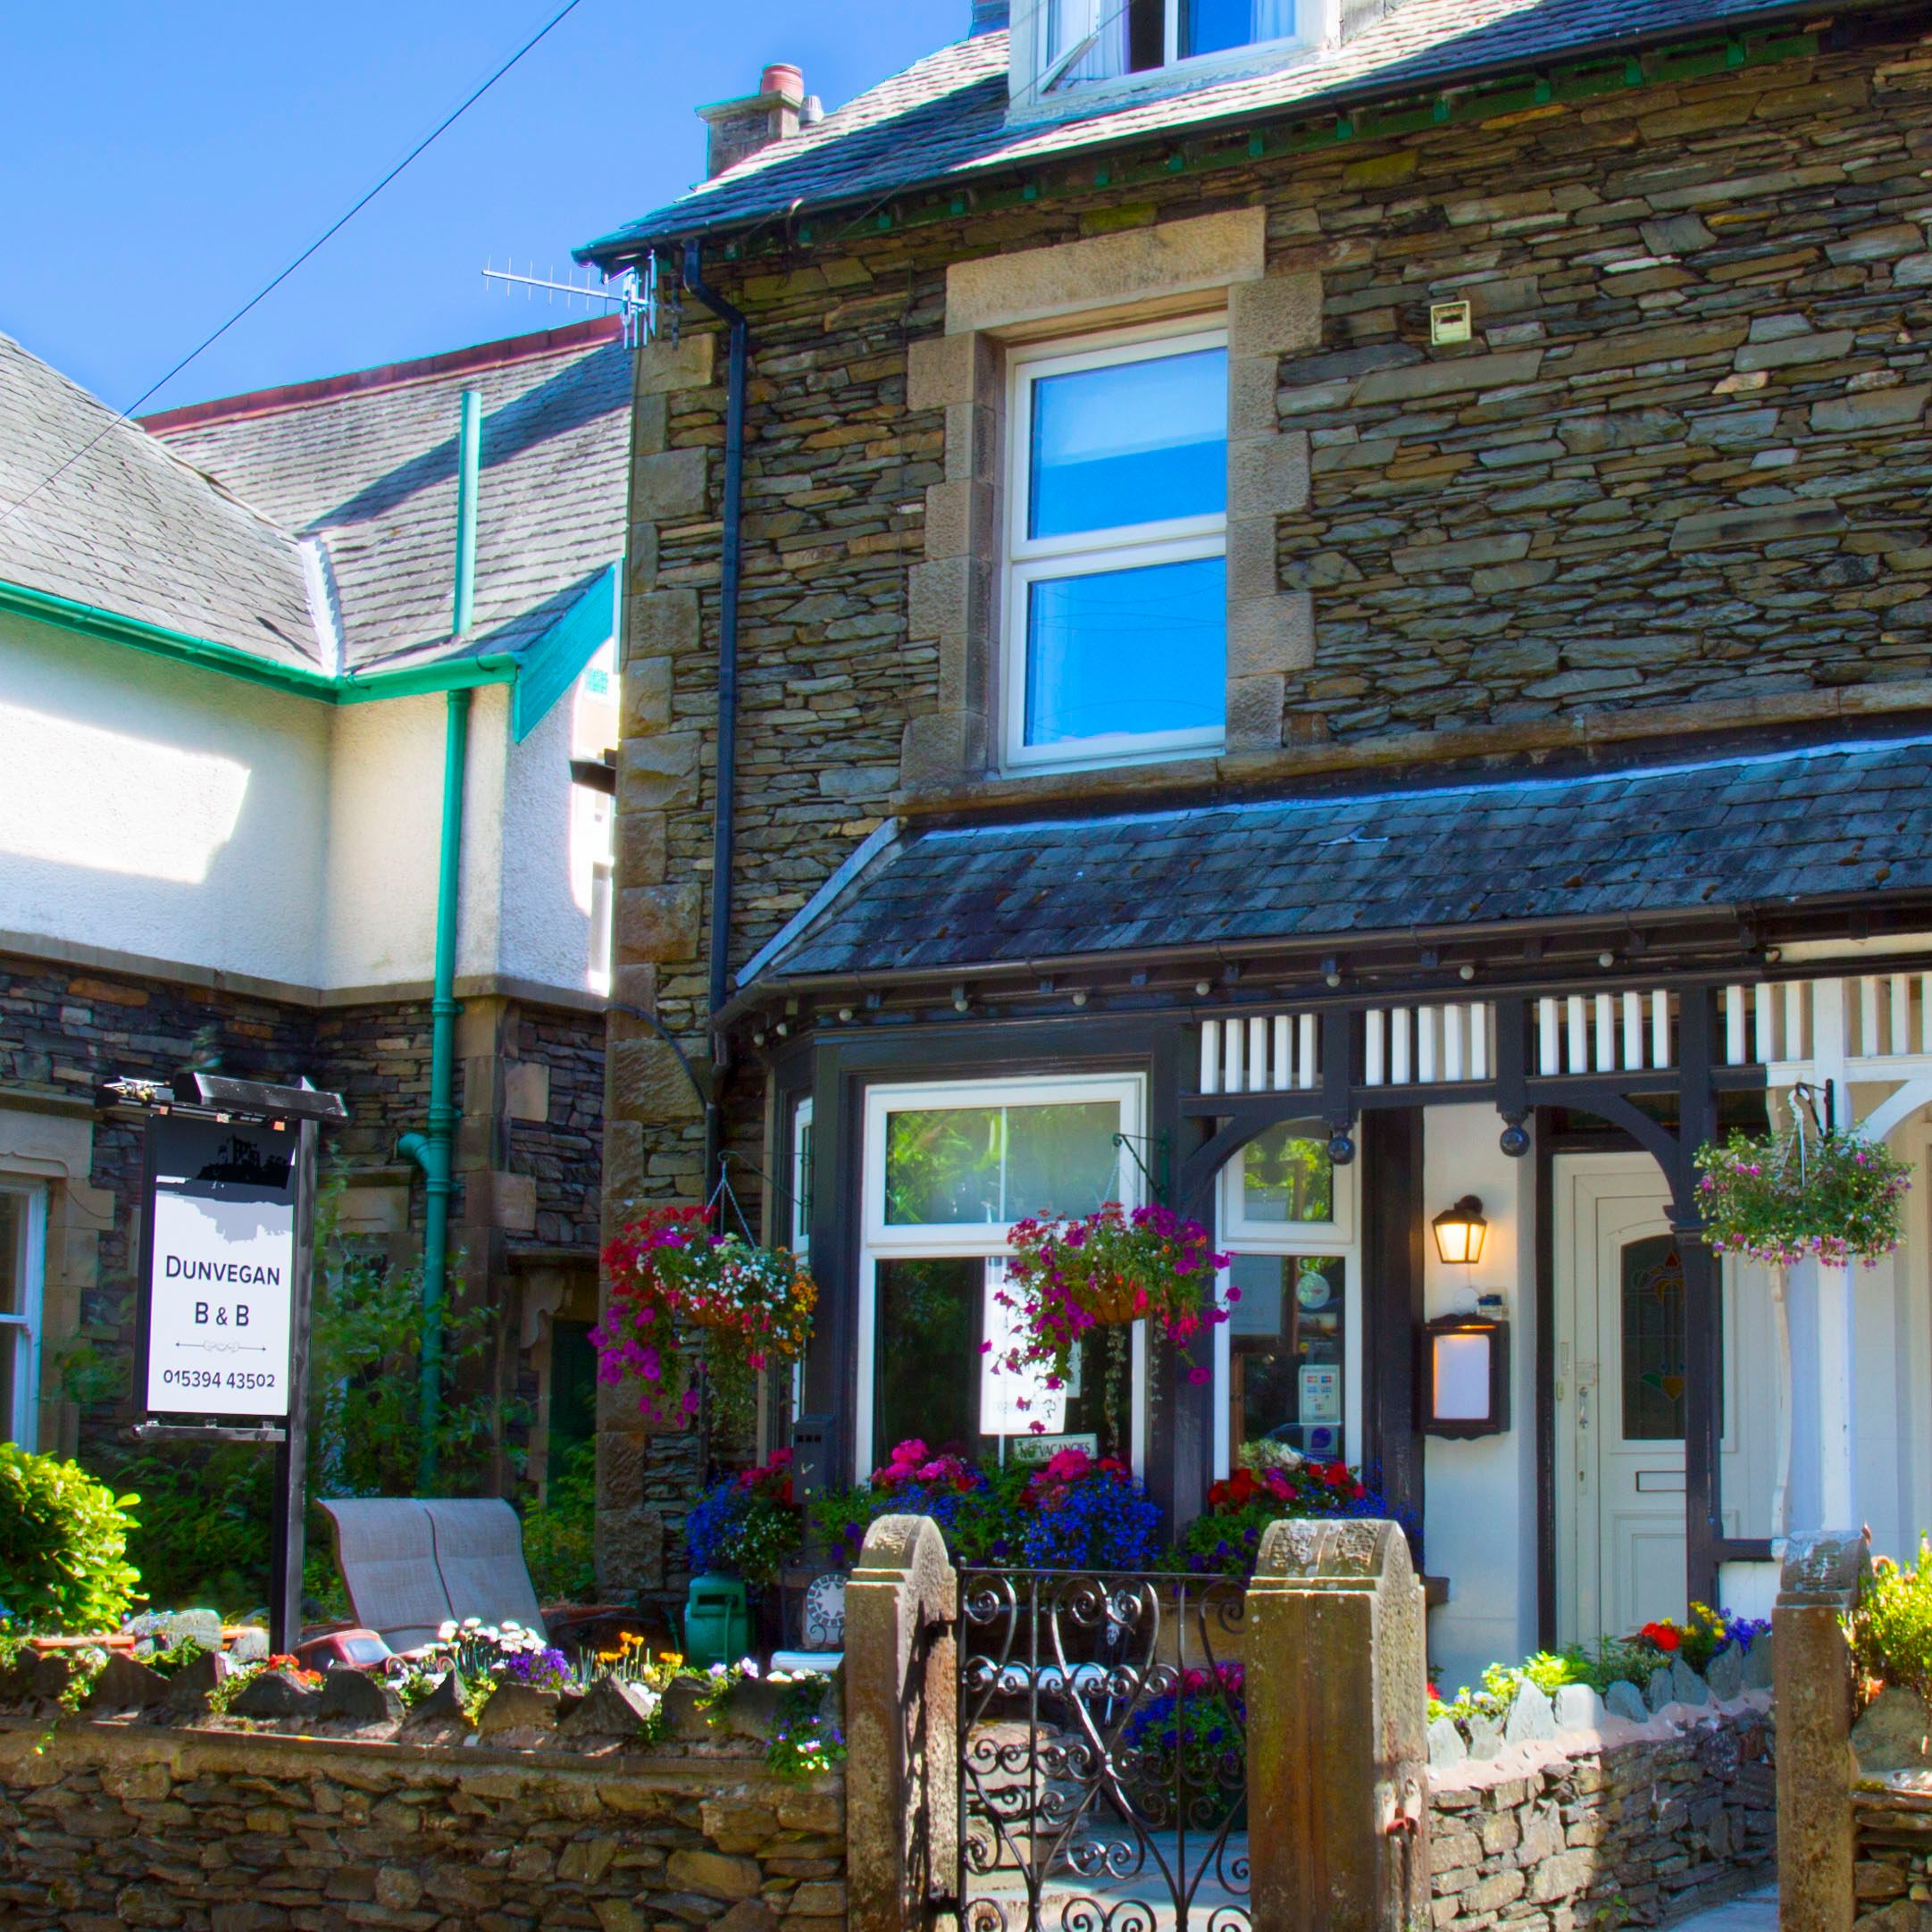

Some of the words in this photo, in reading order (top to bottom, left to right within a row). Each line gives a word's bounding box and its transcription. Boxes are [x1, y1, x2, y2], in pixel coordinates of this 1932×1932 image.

[165, 1255, 280, 1286] DUNVEGAN
[195, 1301, 209, 1326] B
[215, 1307, 229, 1326] &
[236, 1304, 249, 1327] B
[163, 1369, 222, 1389] 015394
[226, 1372, 276, 1390] 43502
